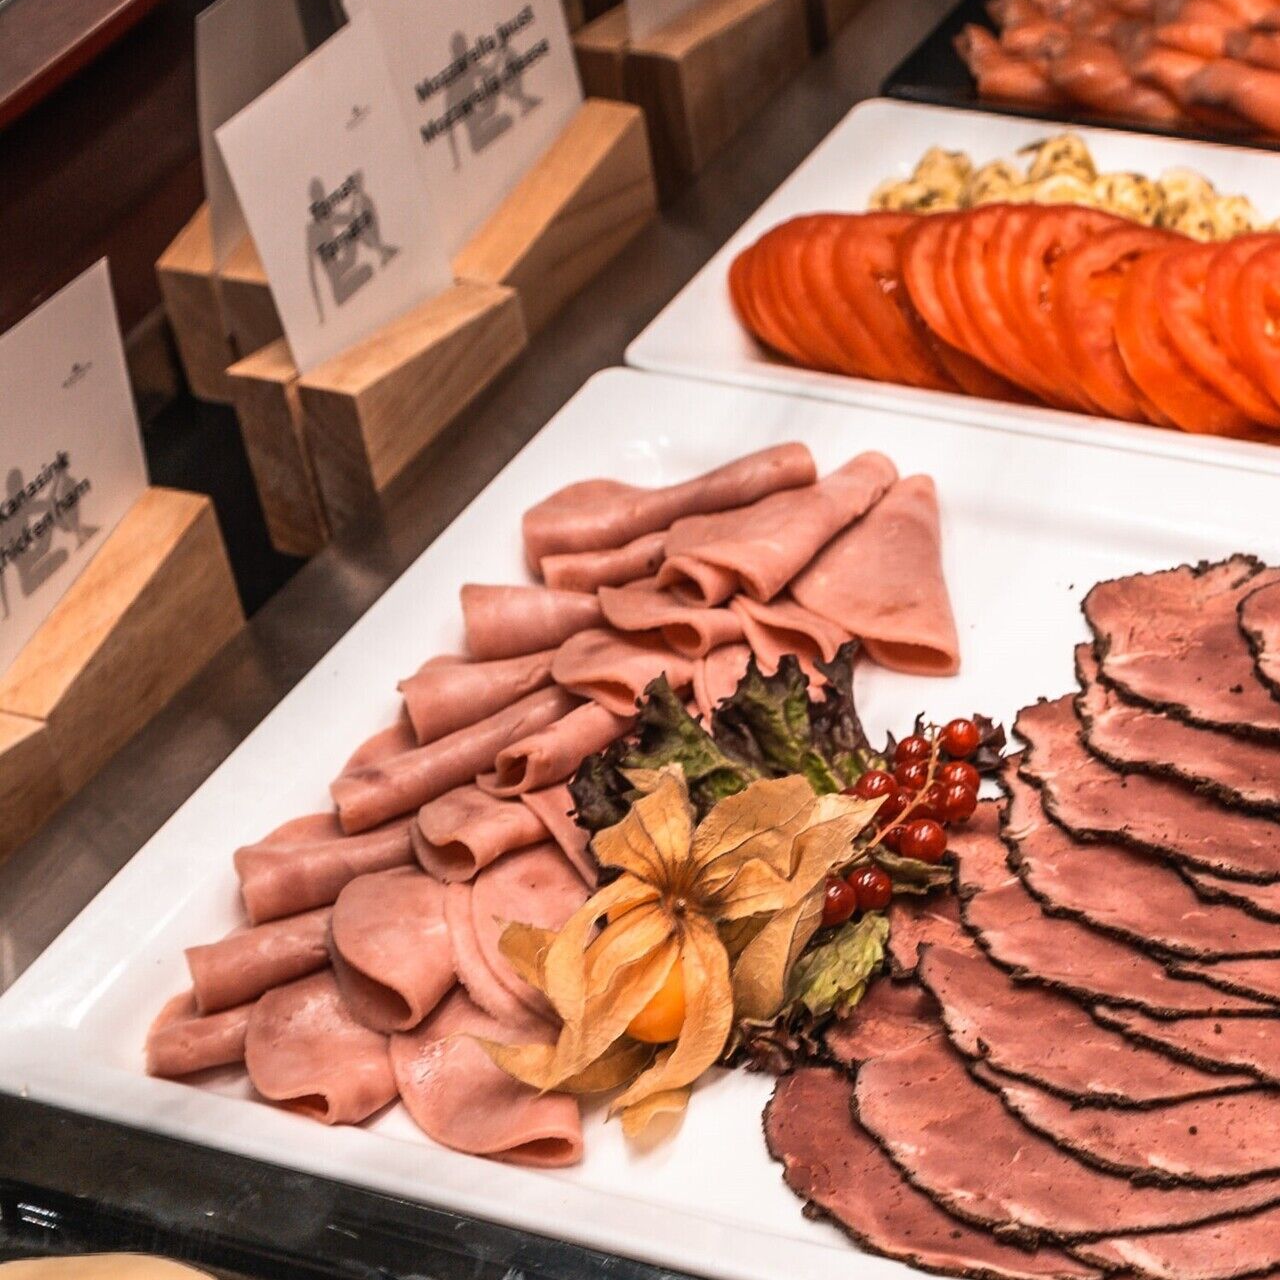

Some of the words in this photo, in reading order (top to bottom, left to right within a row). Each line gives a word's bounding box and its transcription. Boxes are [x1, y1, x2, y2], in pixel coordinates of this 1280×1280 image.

[414, 34, 496, 104] Mozzarella
[420, 74, 501, 145] Mozzarella
[0, 511, 54, 574] hicken
